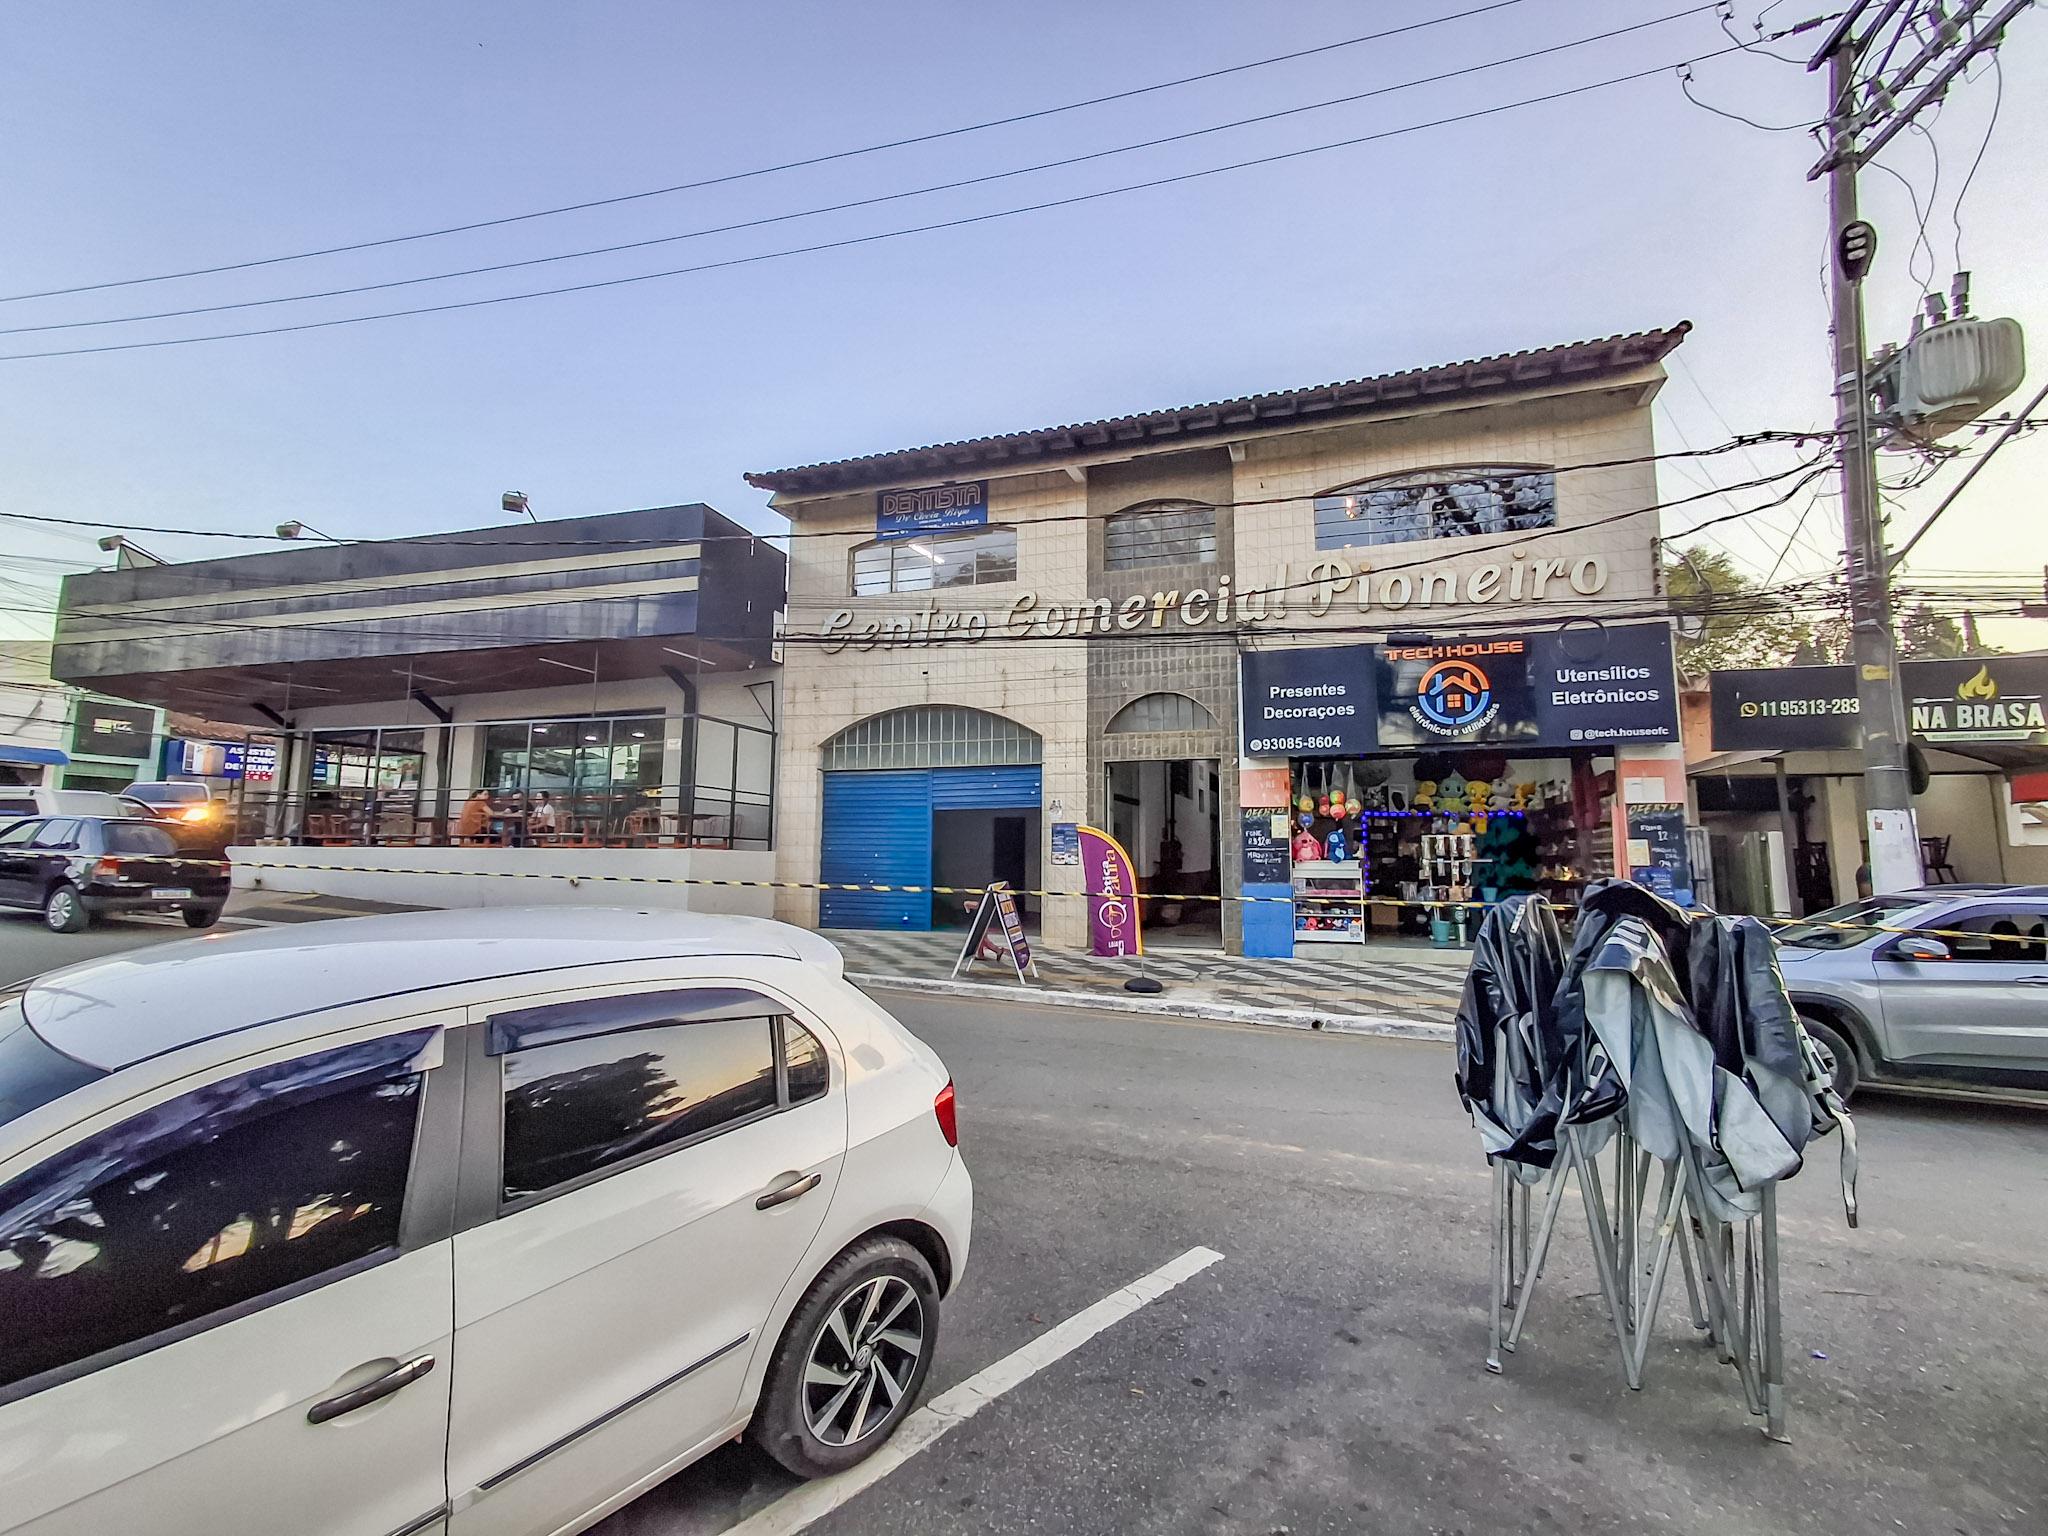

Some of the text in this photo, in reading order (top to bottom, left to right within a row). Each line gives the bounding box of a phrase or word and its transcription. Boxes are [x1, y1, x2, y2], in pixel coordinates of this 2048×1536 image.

[883, 484, 980, 515] DENTISTA
[820, 550, 1608, 654] Centro Comercial Pioneiro
[1384, 640, 1524, 661] TECH HOUSE
[1556, 665, 1651, 683] Utensílios
[1269, 684, 1346, 699] Presentes
[1552, 688, 1660, 705] Eletrônicos
[1760, 698, 1860, 716] 11 95313-283
[1911, 703, 2046, 729] NA BRASA
[1462, 703, 1500, 735] utilidades
[1262, 735, 1341, 750] 93085-8604
[1584, 727, 1669, 740] @tech.houseofc
